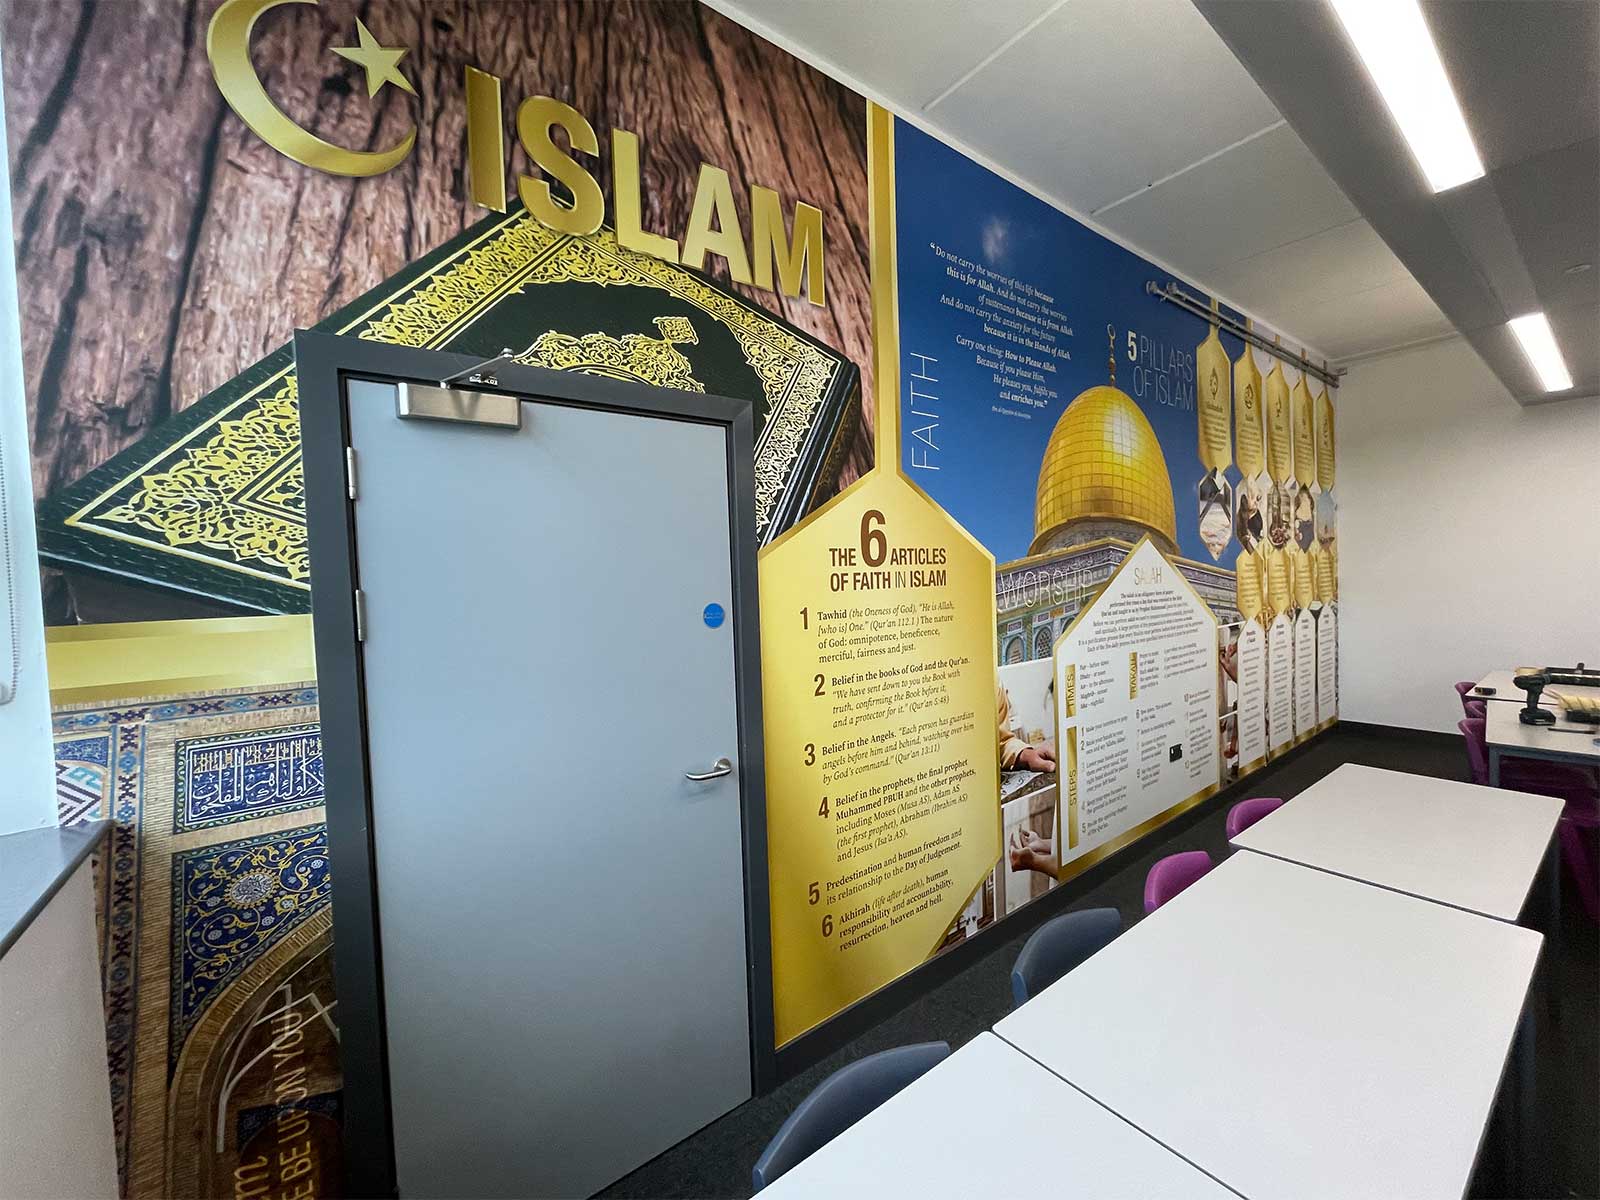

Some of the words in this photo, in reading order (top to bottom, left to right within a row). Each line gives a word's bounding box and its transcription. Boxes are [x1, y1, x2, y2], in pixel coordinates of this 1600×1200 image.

[465, 64, 826, 308] ISLAM
[947, 254, 957, 263] not
[958, 259, 975, 272] carry
[976, 265, 985, 275] the
[947, 266, 959, 278] this
[966, 274, 976, 284] for
[996, 286, 1009, 297] And
[940, 295, 954, 307] And
[964, 305, 975, 314] not
[976, 309, 992, 321] carry
[1016, 308, 1037, 322] because
[956, 336, 975, 350] Carry
[975, 343, 986, 351] one
[1005, 351, 1018, 361] How
[1026, 357, 1042, 368] Please
[984, 325, 1006, 339] because
[1025, 338, 1034, 348] the
[1035, 342, 1050, 353] Hands
[976, 356, 999, 369] Because
[1005, 366, 1016, 374] you
[1127, 330, 1137, 361] 5
[1141, 335, 1193, 382] PILLARS
[1000, 392, 1010, 400] and
[1011, 395, 1033, 405] enriches
[1134, 366, 1152, 398] OF
[1156, 372, 1193, 411] ISLAM
[910, 352, 940, 470] FAITH
[829, 548, 857, 567] THE
[861, 509, 887, 567] 6
[890, 548, 946, 566] ARTICLES
[830, 572, 849, 592] OF
[853, 571, 891, 591] FAITH
[895, 571, 906, 588] IN
[910, 570, 947, 588] ISLAM
[1000, 569, 1093, 608] WORSHIP
[800, 607, 808, 630] 1
[817, 610, 847, 621] Tawhid
[864, 608, 891, 617] Oneness
[893, 606, 900, 616] of
[920, 617, 933, 625] The
[934, 616, 953, 624] nature
[819, 639, 827, 649] of
[829, 638, 848, 648] God:
[849, 634, 899, 646] omnipotence,
[900, 630, 940, 640] beneficence,
[819, 650, 856, 663] merciful,
[857, 649, 886, 658] fairness
[887, 645, 900, 654] and
[814, 673, 826, 697] 2
[832, 674, 855, 686] Belief
[856, 673, 864, 682] in
[866, 671, 878, 681] the
[879, 668, 900, 679] books
[901, 666, 909, 675] of
[910, 664, 923, 674] God
[925, 662, 937, 671] and
[938, 661, 947, 669] the
[849, 688, 866, 697] have
[867, 684, 881, 694] sent
[882, 683, 901, 691] down
[902, 680, 908, 688] to
[909, 679, 920, 689] you
[922, 676, 932, 684] the
[933, 673, 947, 682] Book
[856, 696, 893, 710] confirming
[894, 693, 905, 702] the
[905, 690, 921, 700] Book
[922, 688, 939, 697] before
[833, 717, 847, 729] and
[855, 711, 885, 726] protector
[887, 708, 896, 718] for
[804, 743, 816, 767] 3
[822, 742, 846, 756] Belief
[847, 741, 855, 749] in
[857, 737, 869, 747] the
[871, 731, 897, 744] Angels.
[918, 722, 938, 734] person
[823, 756, 846, 770] angels
[847, 752, 868, 763] before
[870, 747, 883, 757] him
[885, 743, 897, 753] and
[818, 797, 830, 819] 4
[836, 792, 859, 807] Belief
[860, 791, 868, 799] in
[869, 786, 881, 796] the
[883, 777, 916, 794] prophets,
[917, 772, 927, 781] the
[929, 766, 943, 778] final
[944, 759, 968, 775] prophet
[823, 773, 832, 783] by
[836, 799, 882, 820] Muhammed
[883, 792, 904, 805] PBUH
[905, 787, 918, 798] and
[919, 784, 929, 794] the
[931, 780, 947, 790] other
[837, 817, 872, 834] including
[874, 809, 896, 822] Moses
[933, 791, 951, 801] Adam
[853, 829, 867, 842] first
[900, 809, 930, 825] Abraham
[808, 882, 820, 906] 5
[826, 863, 882, 891] Predestination
[884, 855, 897, 867] and
[898, 847, 922, 861] human
[923, 836, 950, 851] freedom
[951, 829, 962, 840] and
[837, 849, 852, 862] and
[853, 844, 873, 856] Jesus
[827, 895, 836, 905] its
[838, 876, 883, 900] relationship
[884, 872, 891, 880] to
[893, 866, 904, 876] the
[905, 861, 917, 871] Day
[919, 855, 927, 865] of
[822, 914, 833, 938] 6
[839, 903, 871, 924] Akhirah
[926, 871, 949, 884] human
[840, 908, 890, 936] responsibility
[892, 900, 905, 912] and
[891, 910, 914, 926] heaven
[915, 901, 928, 913] and
[270, 1012, 304, 1069] YOU
[275, 1066, 310, 1143] UPON
[279, 1141, 313, 1182] BE
